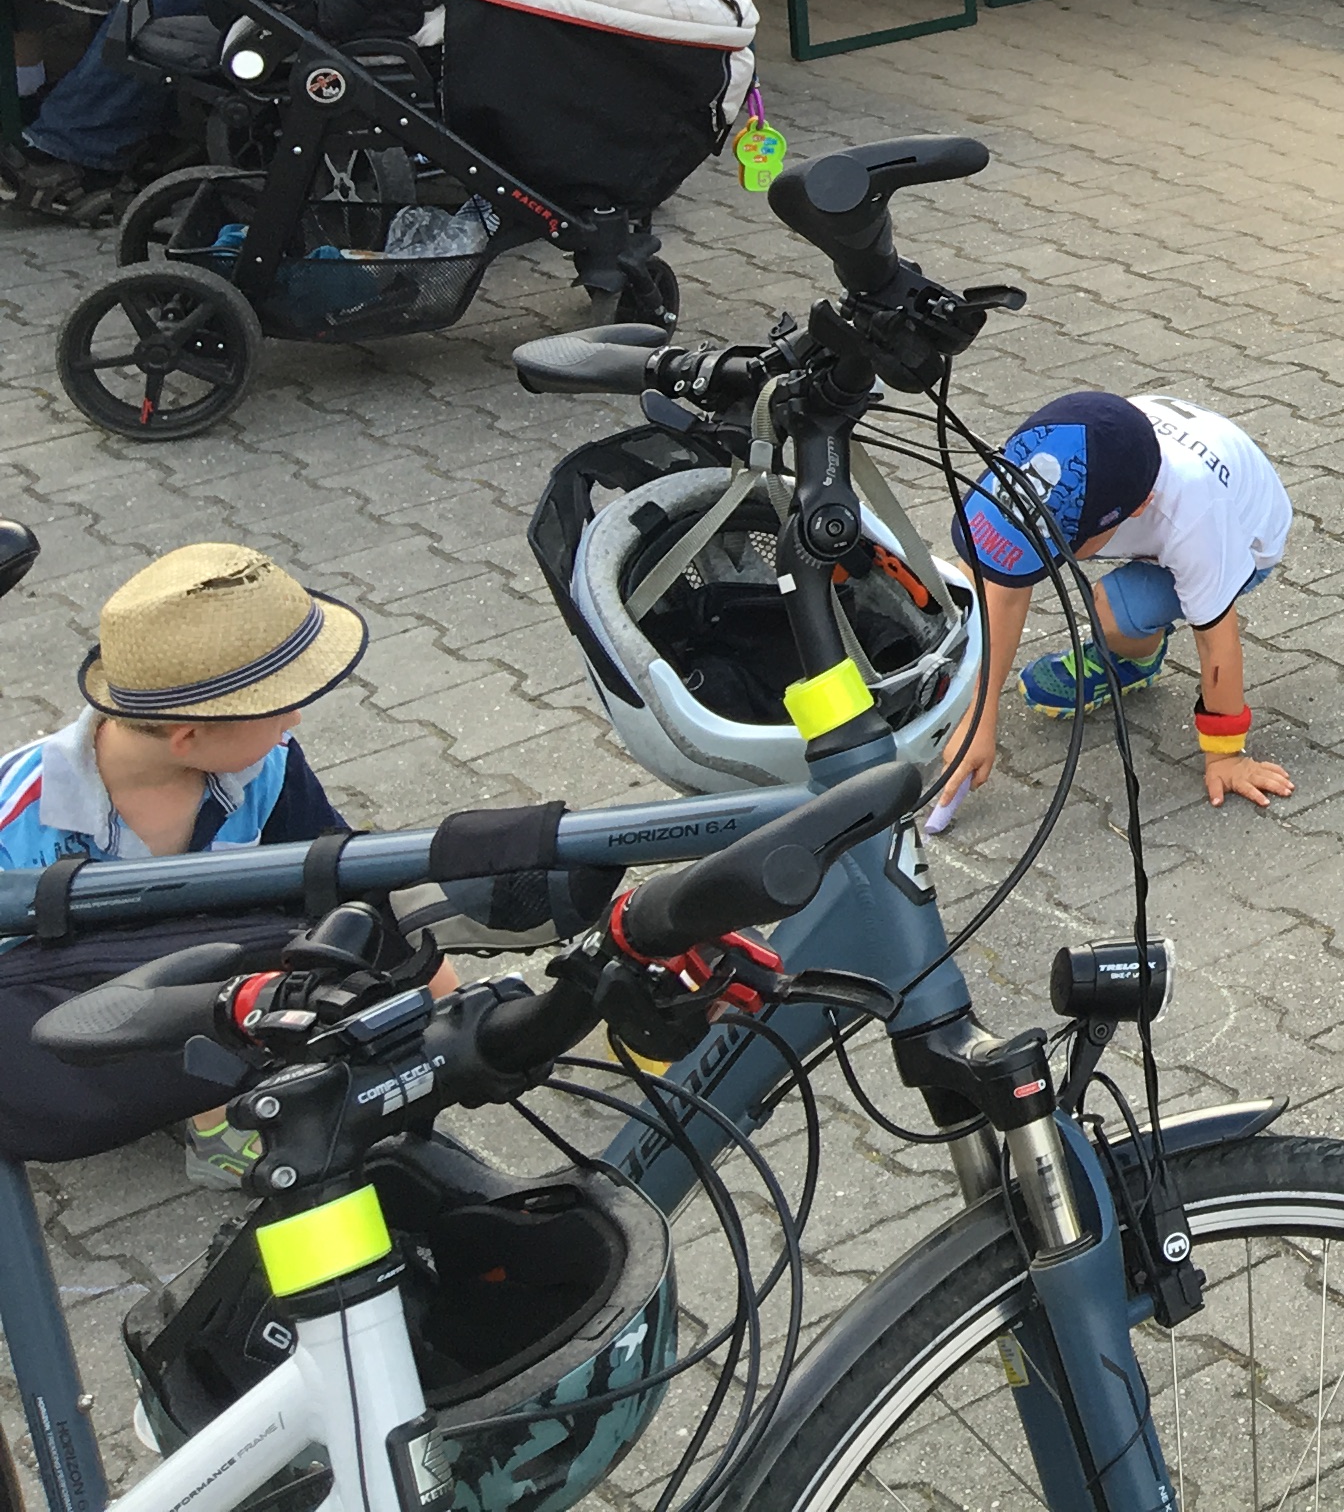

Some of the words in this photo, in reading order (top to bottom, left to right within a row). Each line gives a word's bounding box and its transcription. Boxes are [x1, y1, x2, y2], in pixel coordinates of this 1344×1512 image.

[969, 510, 1025, 572] POWER
[607, 824, 699, 848] HORIZON
[705, 818, 738, 835] 6.4
[1099, 961, 1157, 972] TRELOK
[56, 1420, 84, 1496] HORIZON
[236, 1422, 279, 1459] FRAME
